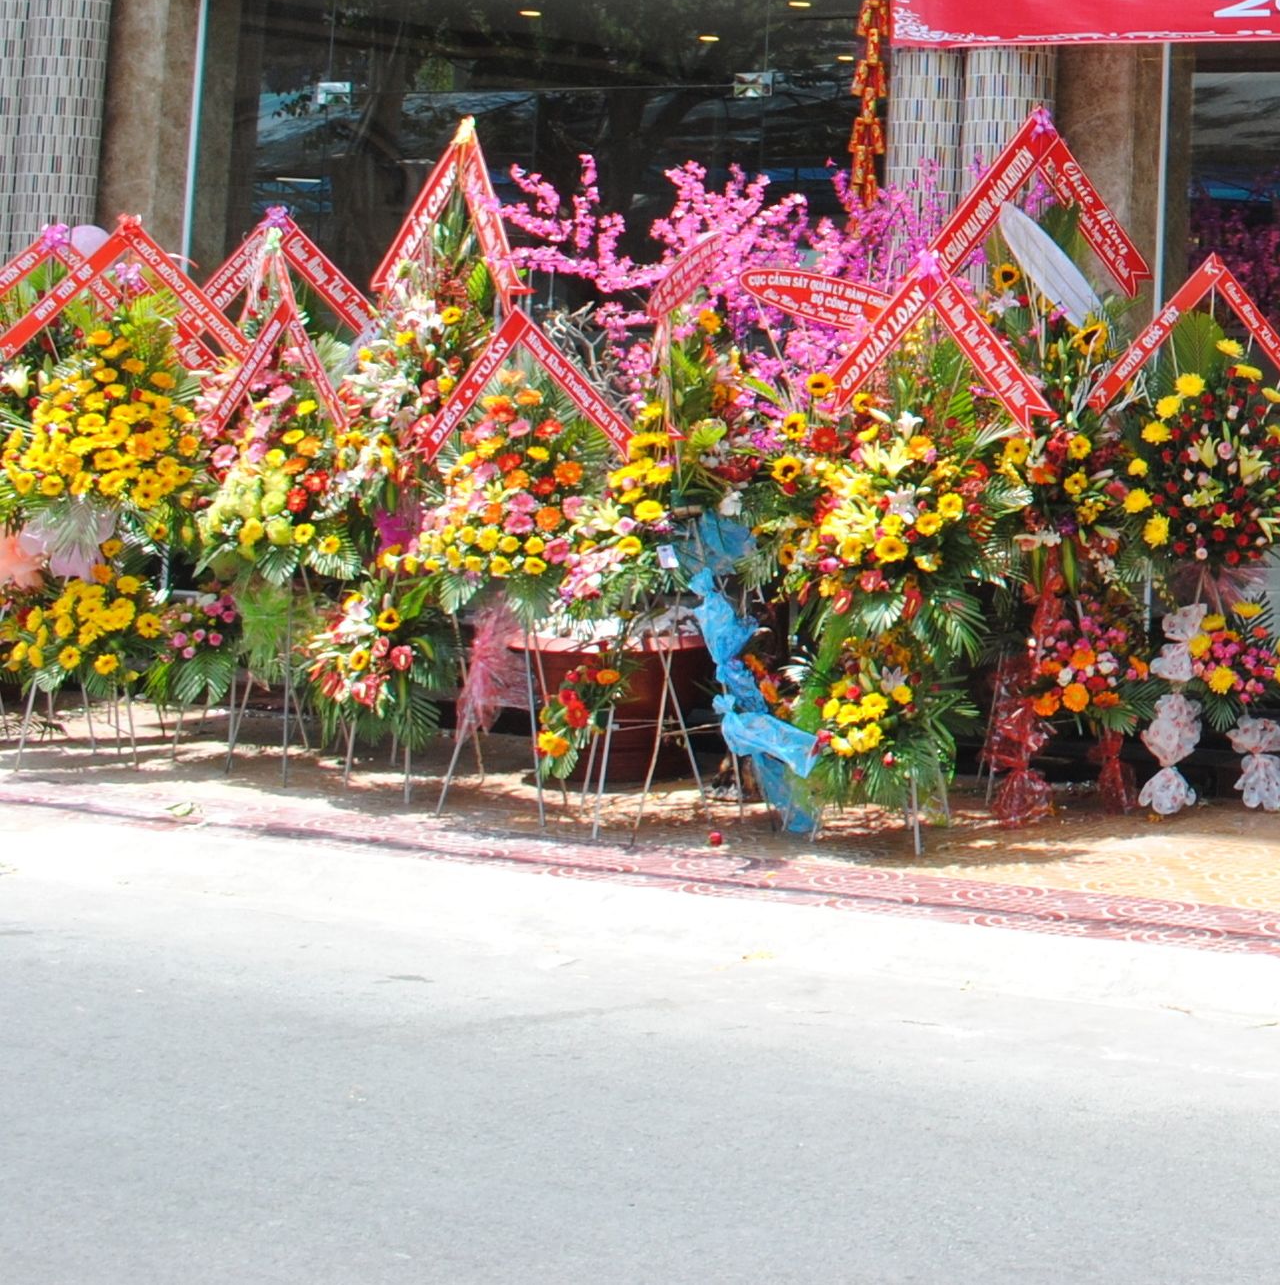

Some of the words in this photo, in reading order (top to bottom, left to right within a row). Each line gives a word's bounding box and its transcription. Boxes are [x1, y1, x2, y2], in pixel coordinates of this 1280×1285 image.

[1061, 160, 1095, 204] Chúc
[1091, 204, 1130, 254] Mừng
[182, 288, 209, 316] KHAI
[885, 285, 928, 333] LOAN
[1258, 326, 1278, 349] Khai
